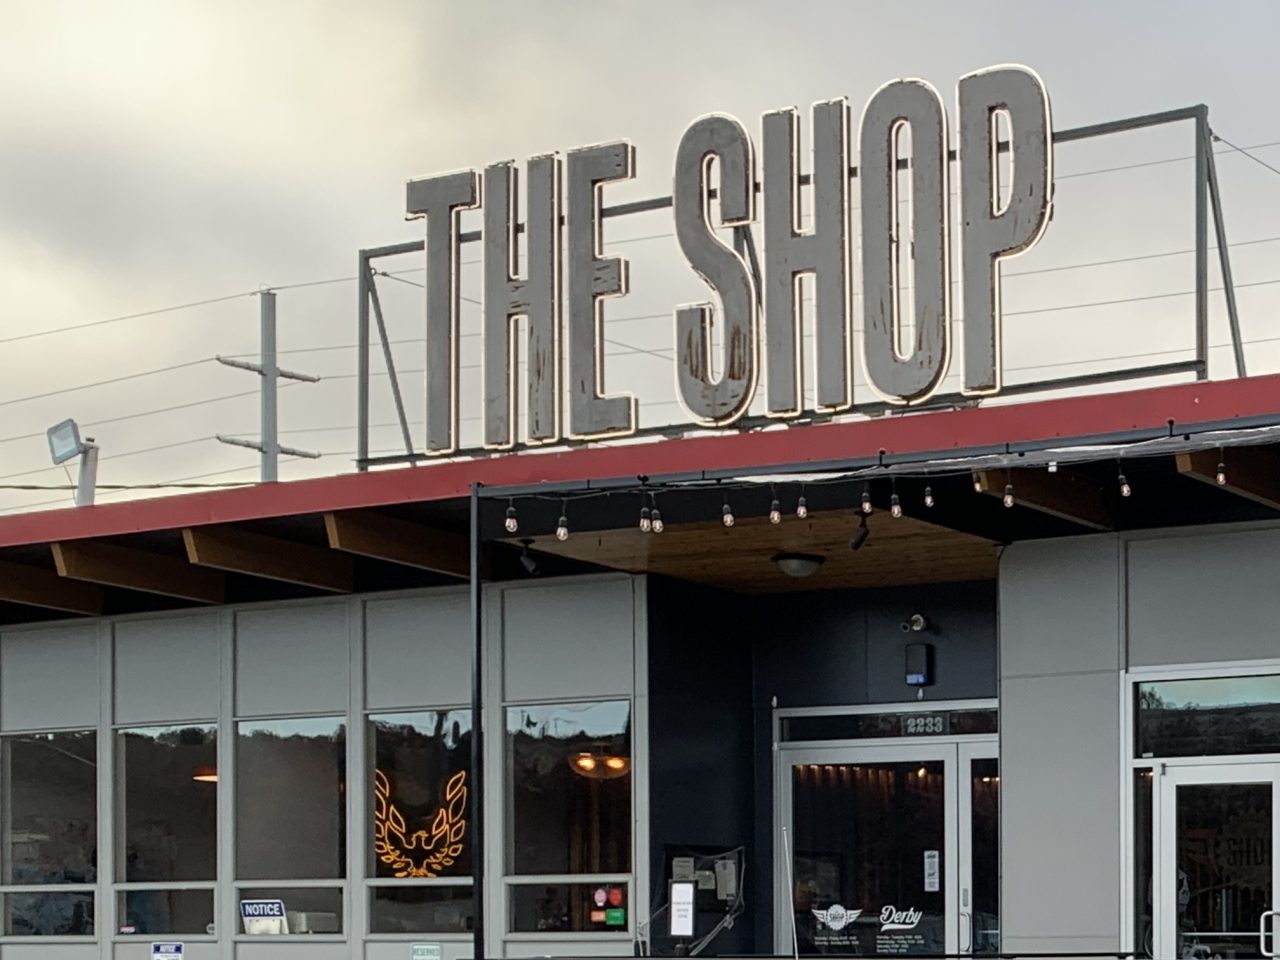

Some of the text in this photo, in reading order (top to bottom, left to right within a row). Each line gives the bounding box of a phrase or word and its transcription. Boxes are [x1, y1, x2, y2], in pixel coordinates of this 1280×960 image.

[405, 63, 1055, 456] THE SHOP
[244, 903, 281, 916] NOTICE
[880, 905, 923, 932] Derby
